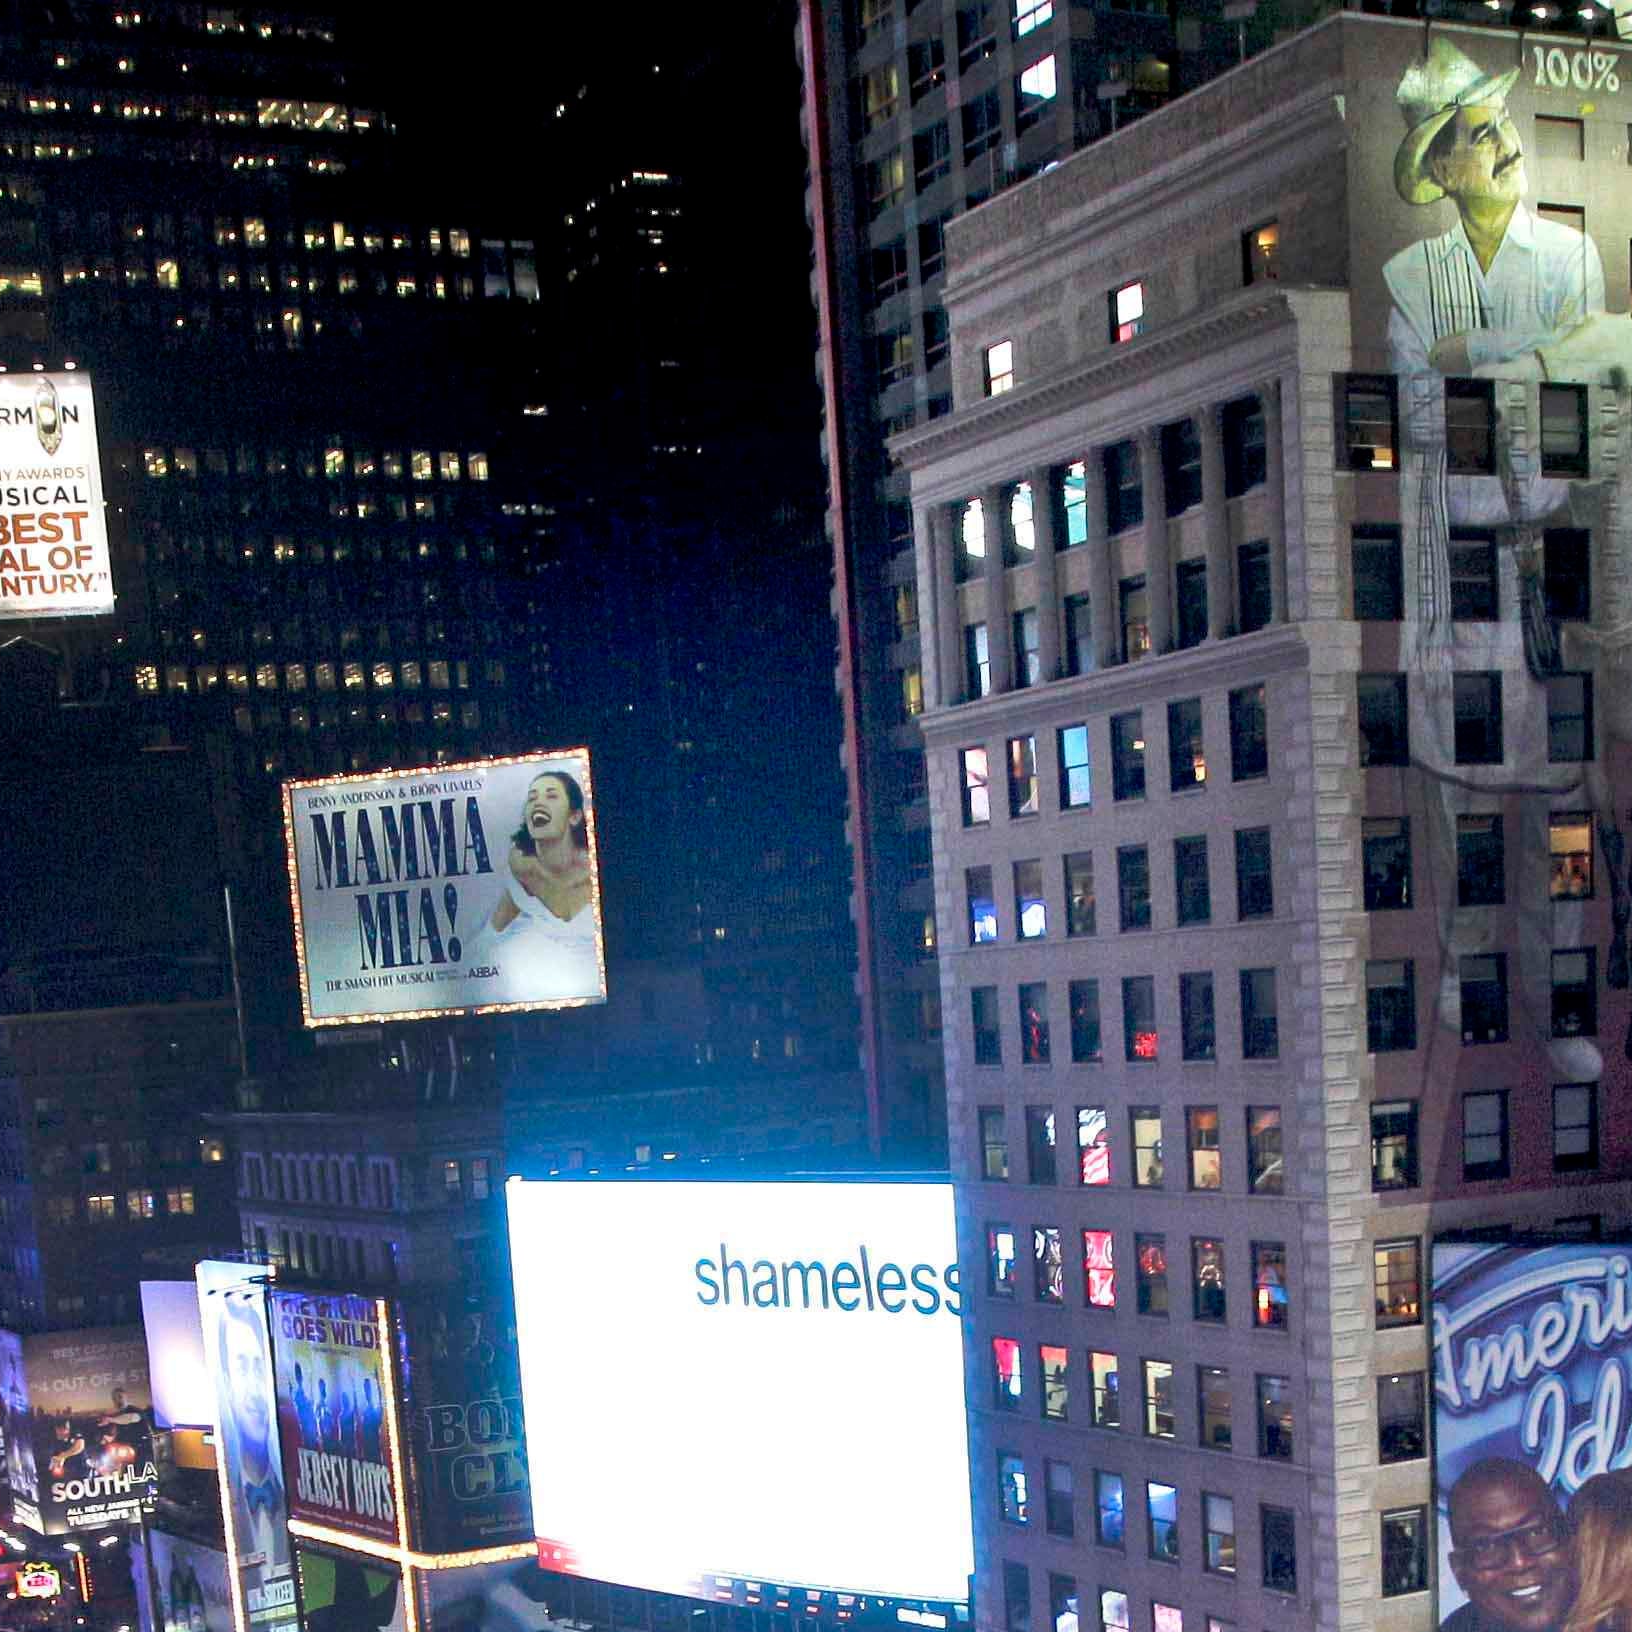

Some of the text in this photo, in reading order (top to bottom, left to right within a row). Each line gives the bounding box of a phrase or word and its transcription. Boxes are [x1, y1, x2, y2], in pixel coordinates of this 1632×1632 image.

[1534, 46, 1620, 93] 100%
[16, 466, 86, 481] AWARDS
[48, 545, 93, 572] OF
[309, 796, 494, 891] MAMMA
[353, 882, 463, 971] MIA!
[280, 1314, 329, 1343] GOES
[296, 1447, 352, 1513] JERSEY
[352, 1457, 395, 1523] BOYS
